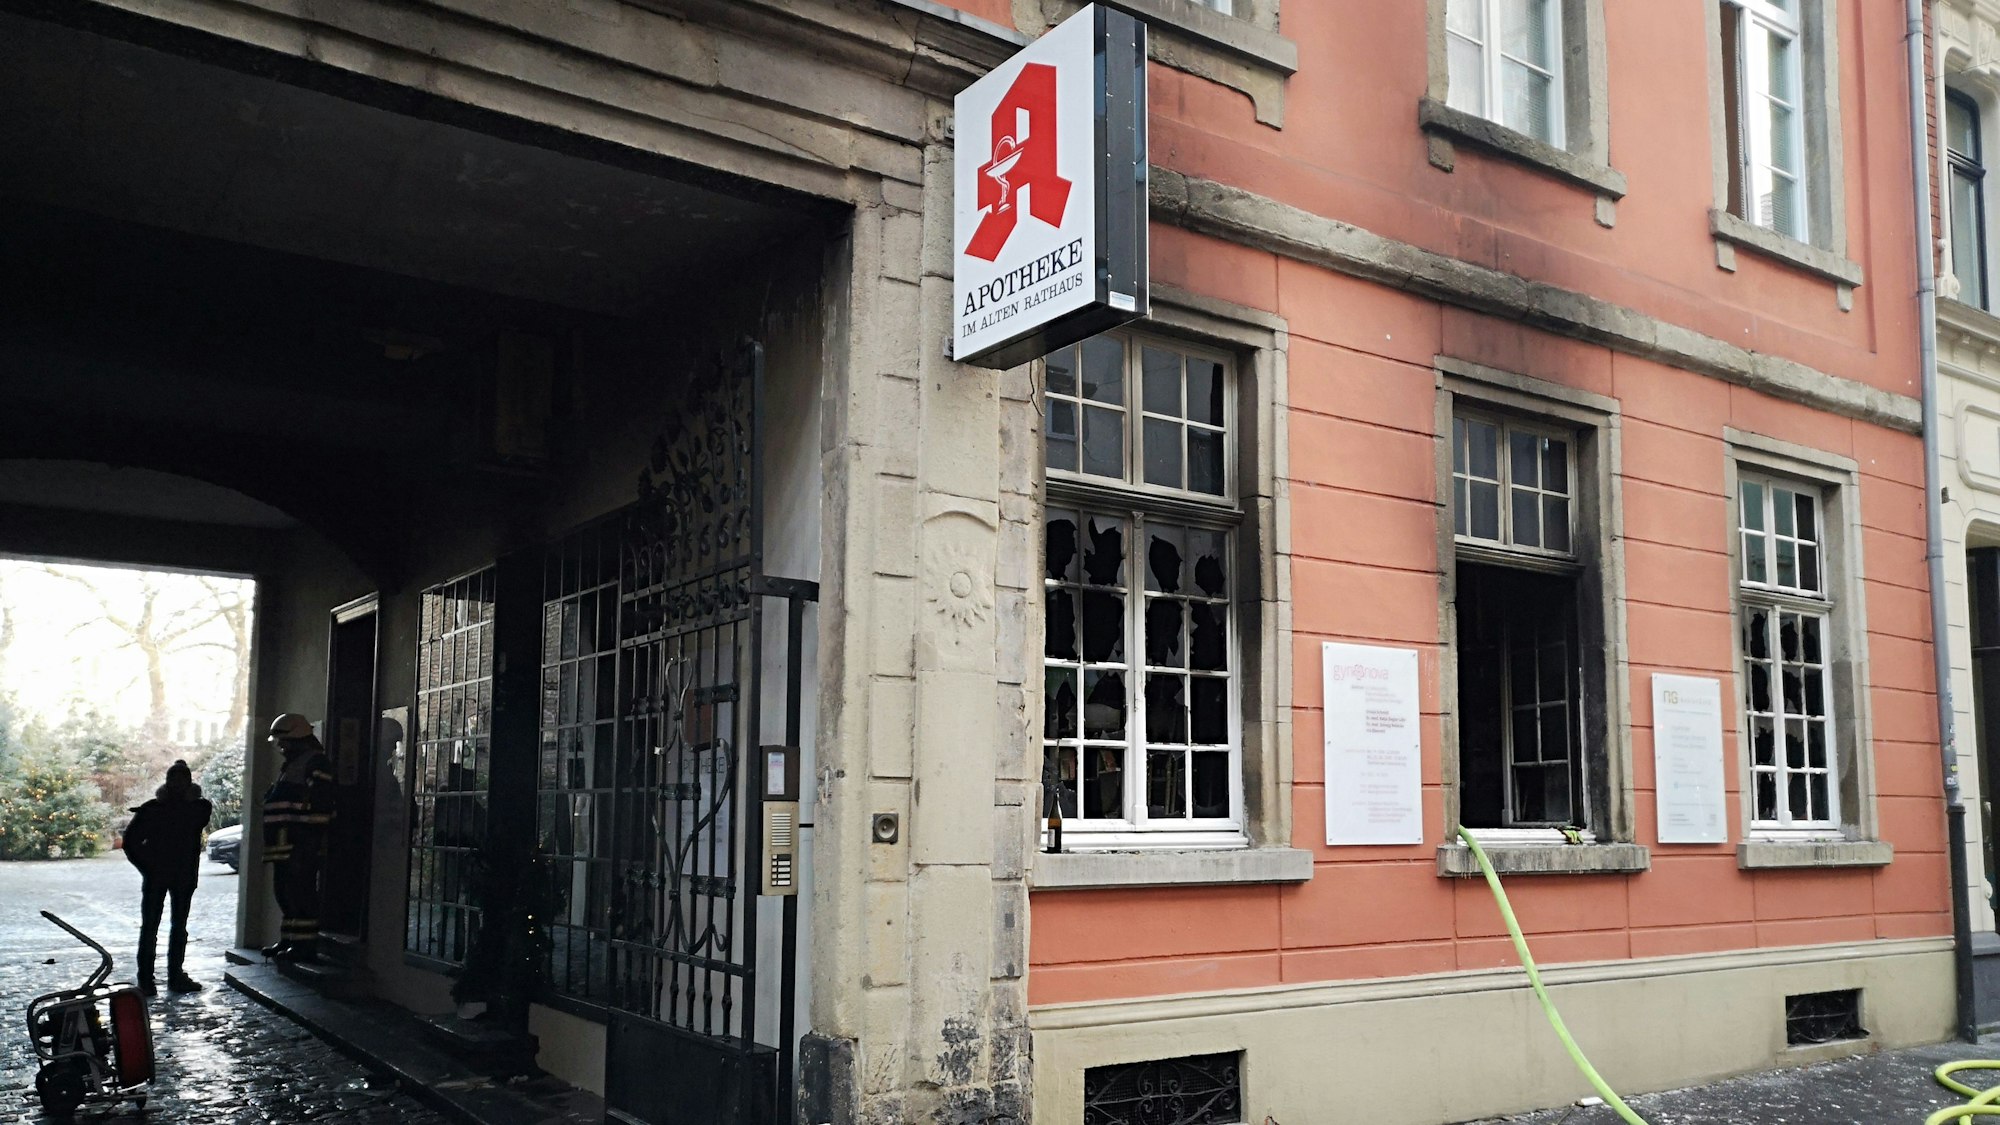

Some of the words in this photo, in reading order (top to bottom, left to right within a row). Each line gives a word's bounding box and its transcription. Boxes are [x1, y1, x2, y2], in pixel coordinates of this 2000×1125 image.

[962, 237, 1083, 317] APOTHEKE
[962, 321, 977, 338] IM
[980, 301, 1020, 330] ALTEN
[1024, 272, 1083, 311] RATHAUS
